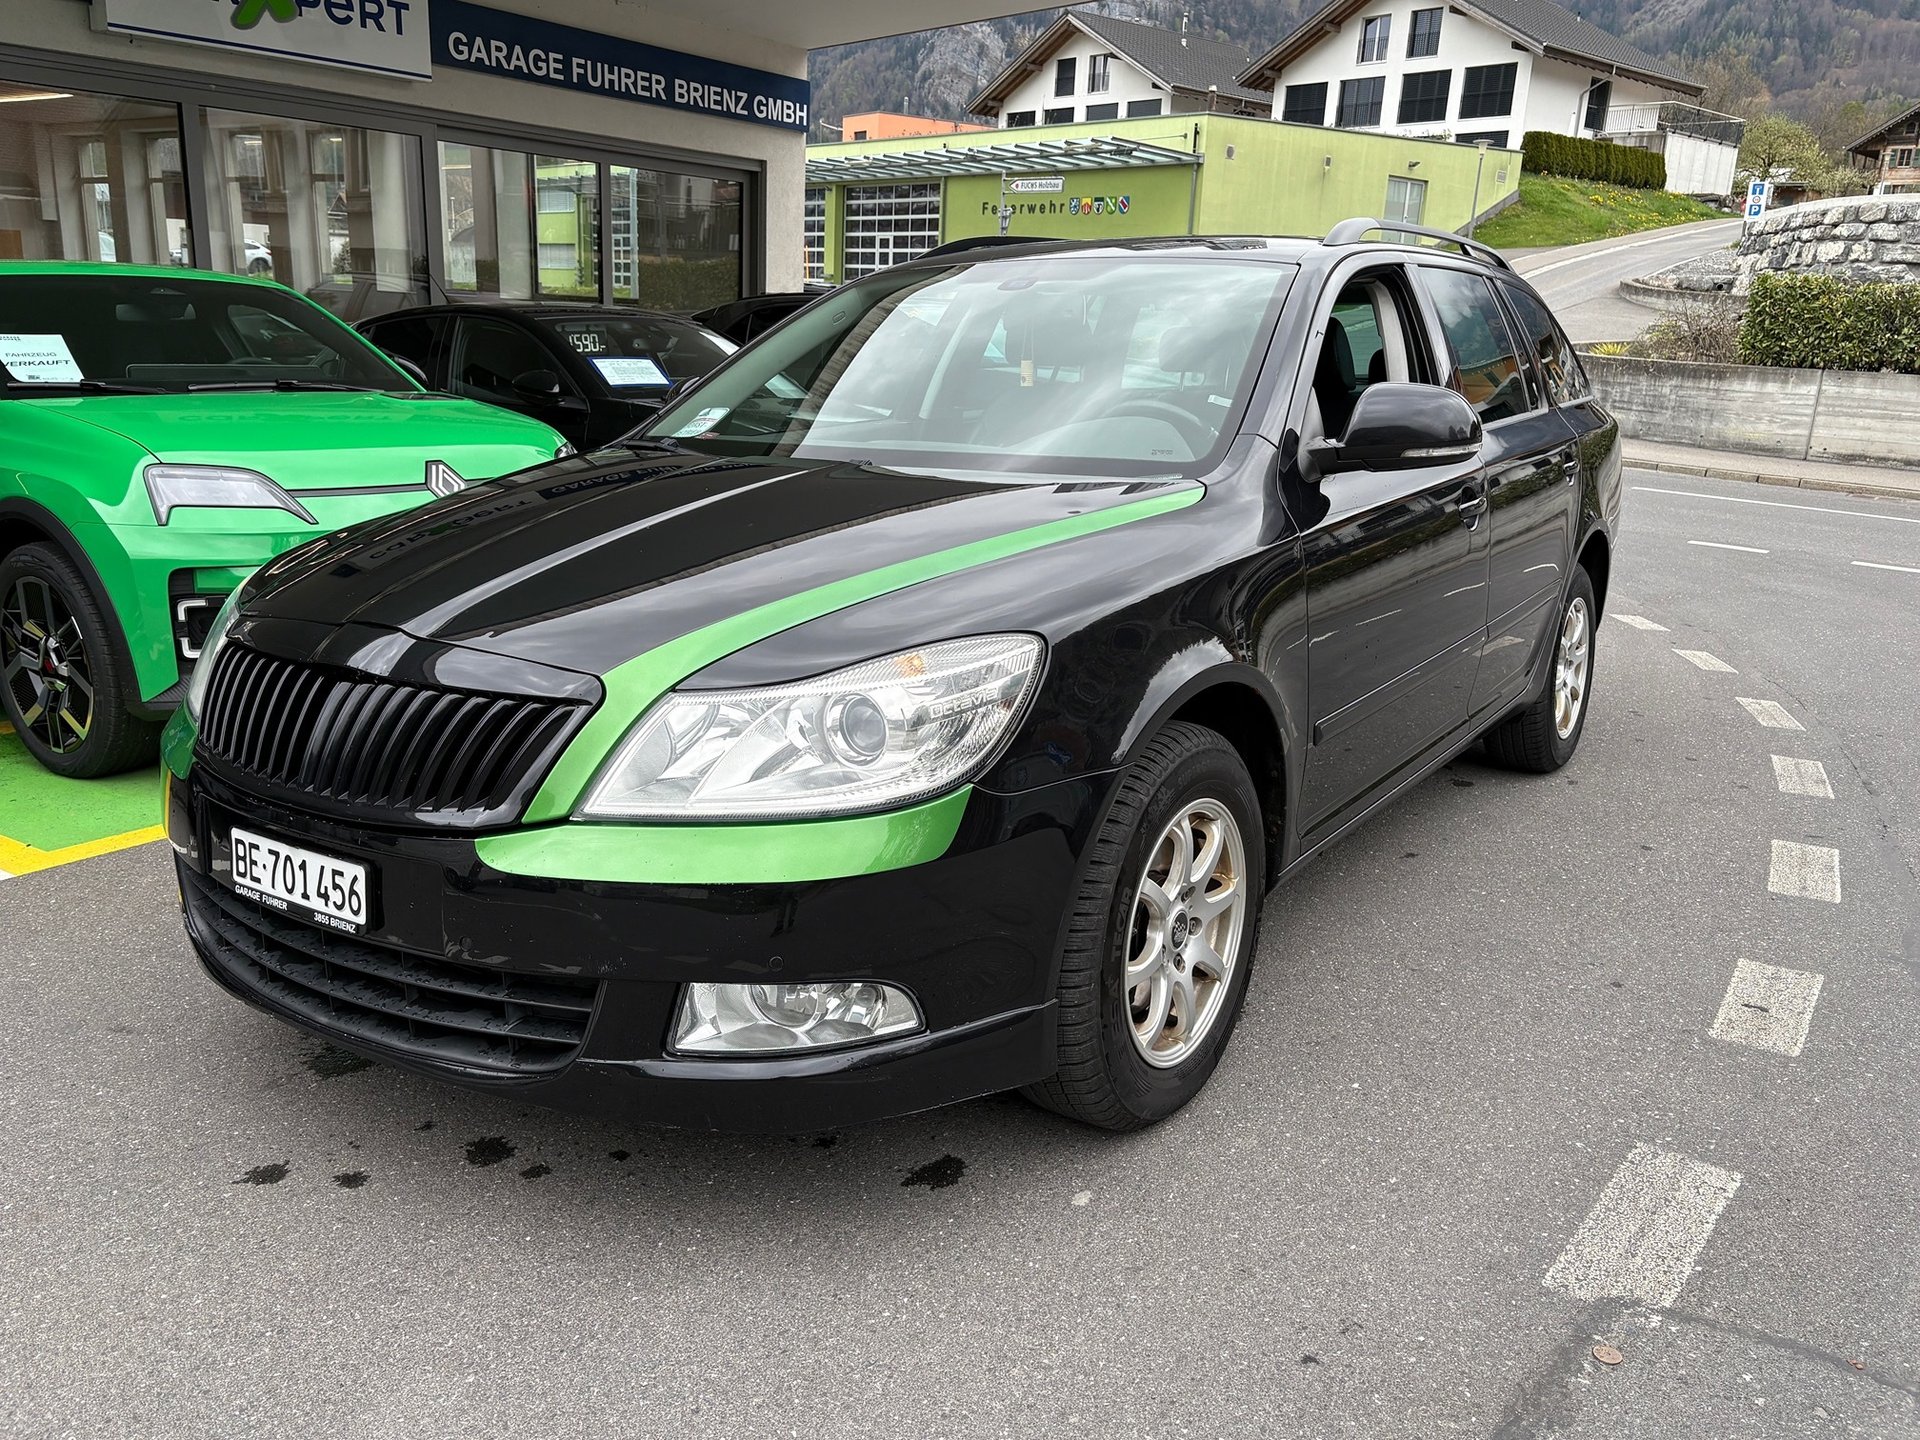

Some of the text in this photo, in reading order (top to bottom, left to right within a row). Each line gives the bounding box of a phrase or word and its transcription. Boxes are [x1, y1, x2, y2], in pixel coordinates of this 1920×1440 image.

[448, 31, 808, 126] GARAGE FUHRER BRIENZ GMBH
[1038, 181, 1060, 189] Holzbau
[982, 200, 1065, 215] Feerwehr
[234, 884, 356, 933] GARAGE FUHRER 3855 BRIENZ
